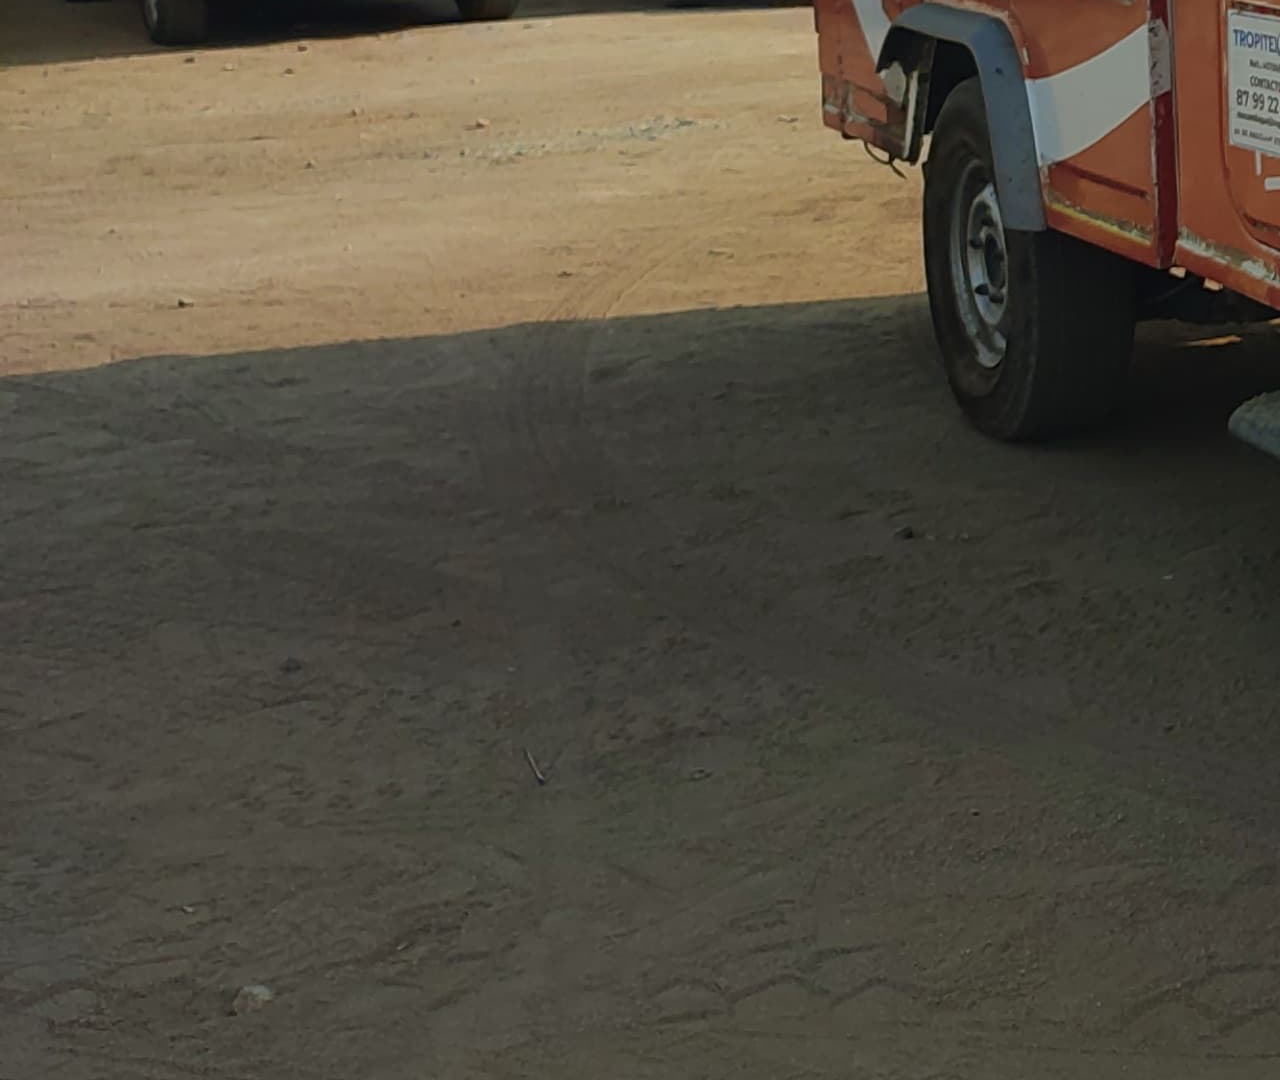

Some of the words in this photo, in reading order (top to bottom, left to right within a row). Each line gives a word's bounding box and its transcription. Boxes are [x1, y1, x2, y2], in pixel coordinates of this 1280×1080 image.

[1236, 88, 1249, 107] 87
[1252, 91, 1265, 111] 99
[1267, 95, 1279, 115] 22
